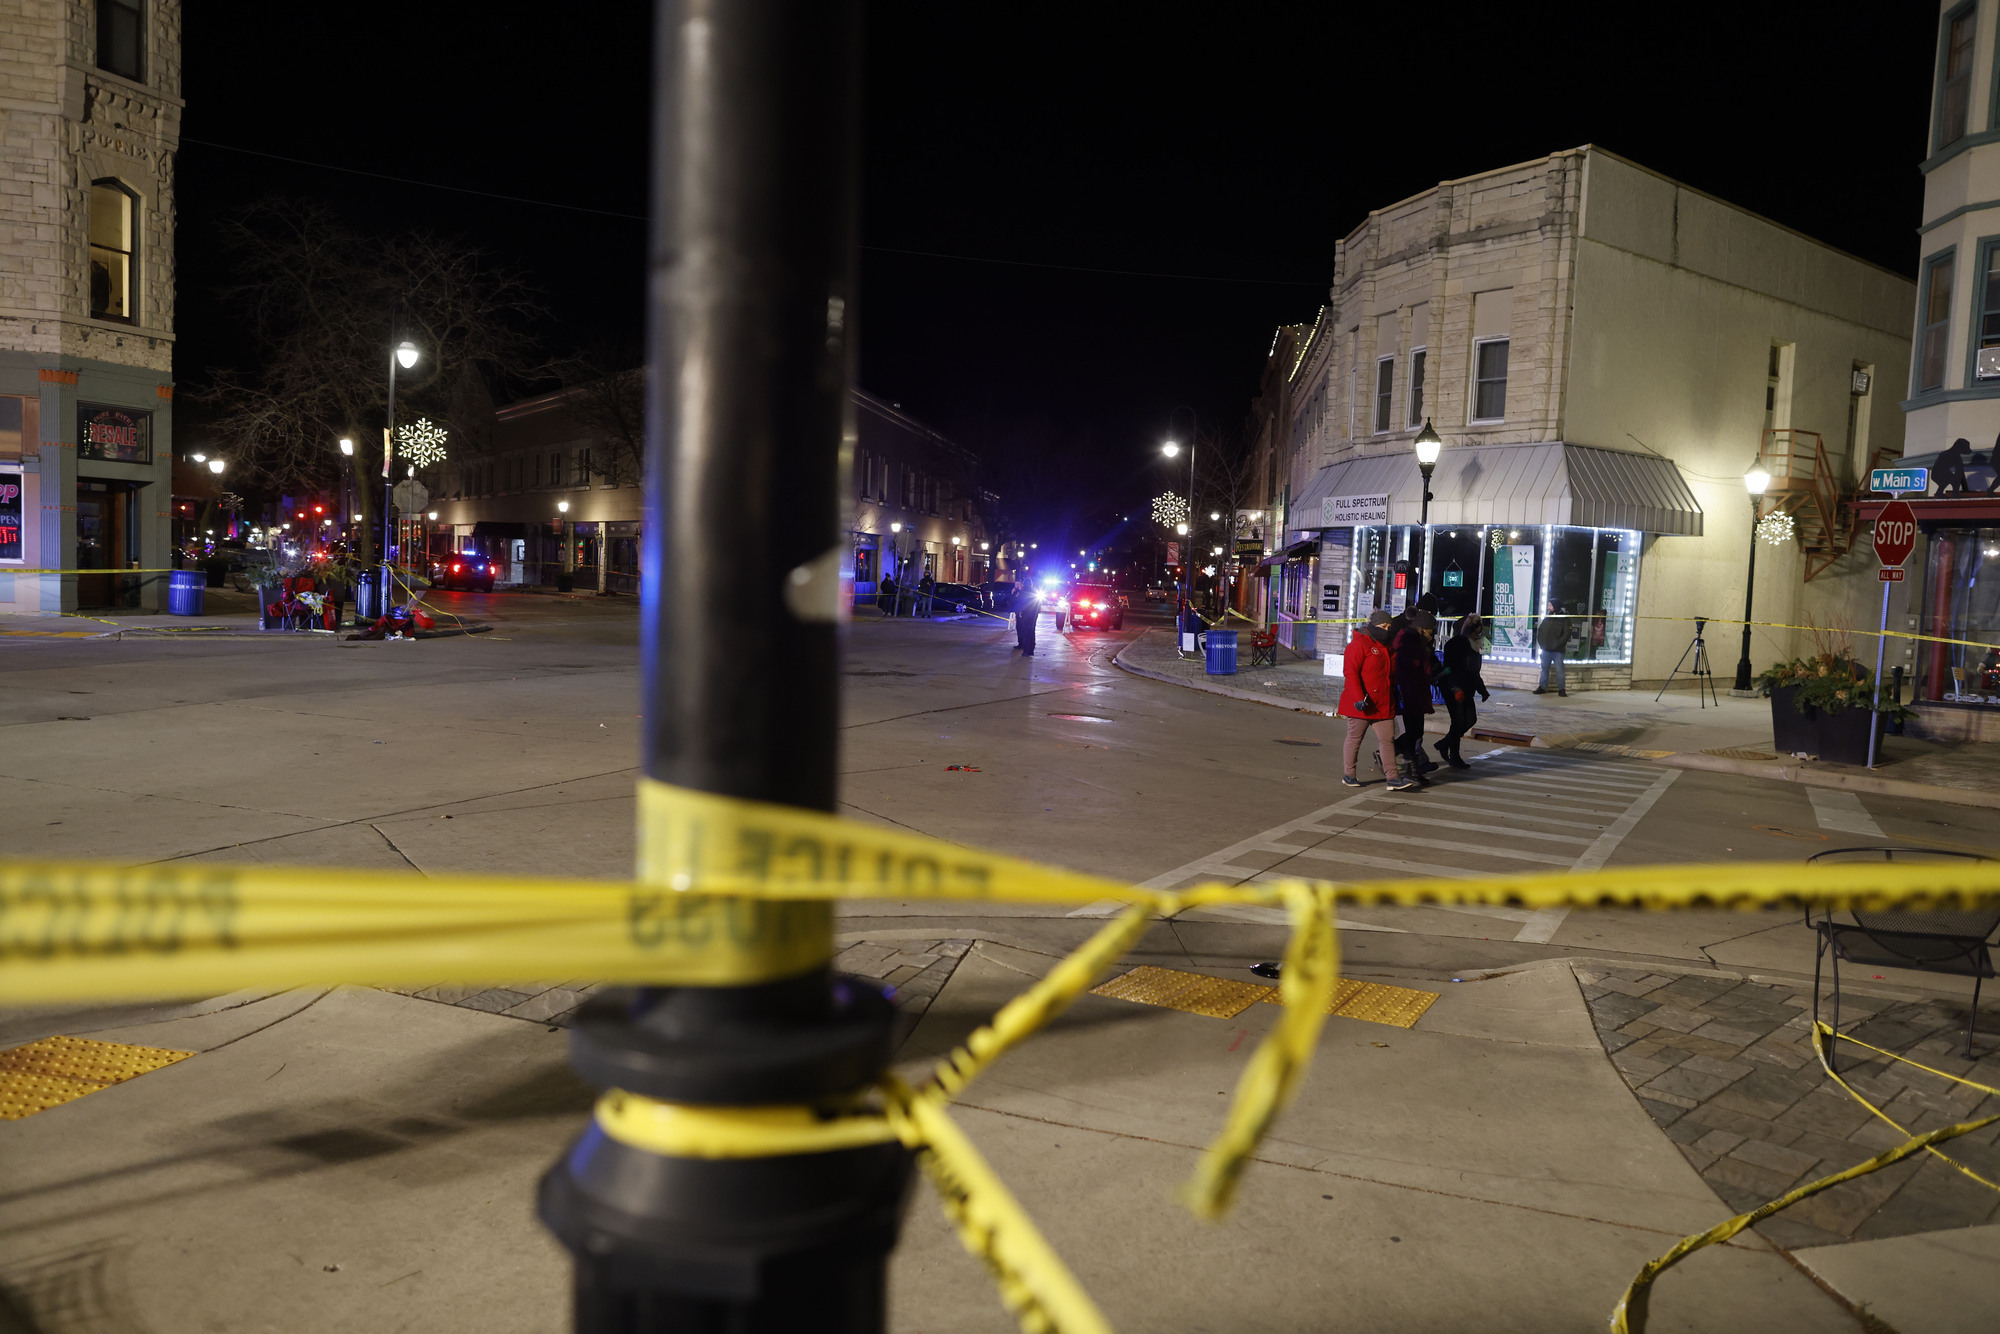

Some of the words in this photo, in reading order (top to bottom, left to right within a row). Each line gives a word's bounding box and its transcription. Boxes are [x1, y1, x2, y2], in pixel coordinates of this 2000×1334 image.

[81, 129, 161, 176] PUTNEY
[90, 423, 137, 446] RESALE
[1883, 472, 1911, 488] Main
[1335, 499, 1351, 509] FULL
[1352, 497, 1387, 508] SPECTRUM
[1334, 512, 1360, 521] HOLISTIC
[1360, 511, 1386, 520] HEALING
[1876, 520, 1914, 546] STOP
[1880, 571, 1890, 579] ALL
[1892, 571, 1903, 580] WAY
[1495, 583, 1510, 594] CBD
[1494, 593, 1514, 605] SOLD
[1494, 605, 1514, 616] HERE
